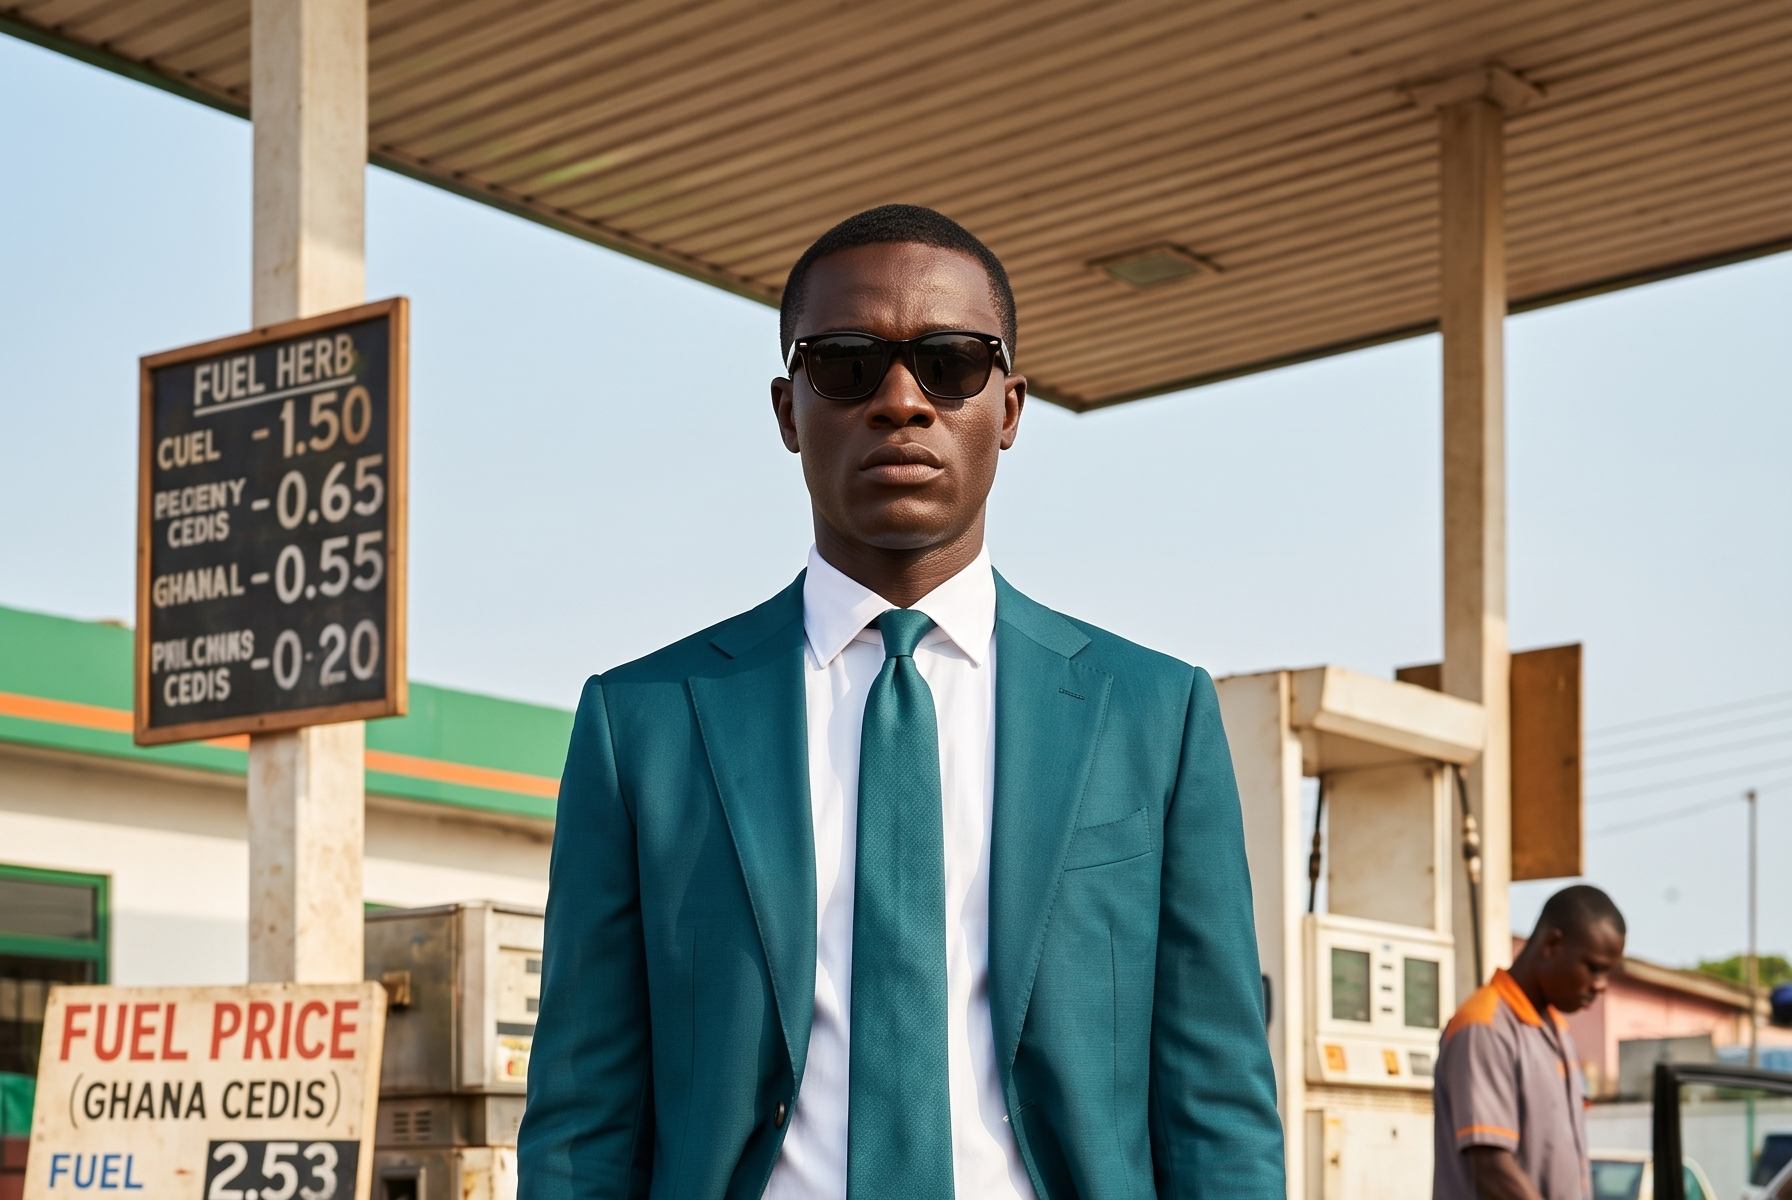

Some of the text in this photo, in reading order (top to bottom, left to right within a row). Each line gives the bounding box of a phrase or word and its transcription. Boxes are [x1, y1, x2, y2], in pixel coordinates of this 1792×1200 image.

[193, 333, 355, 407] FUEL HERB
[157, 429, 221, 470] CUEL
[167, 510, 230, 549] CEDIS
[152, 562, 245, 609] GHANAL
[163, 667, 231, 708] CEDIS
[59, 1000, 359, 1062] FUEL PRICE
[69, 1070, 341, 1129] (GHANA CEDIS)
[48, 1153, 144, 1190] FUEL
